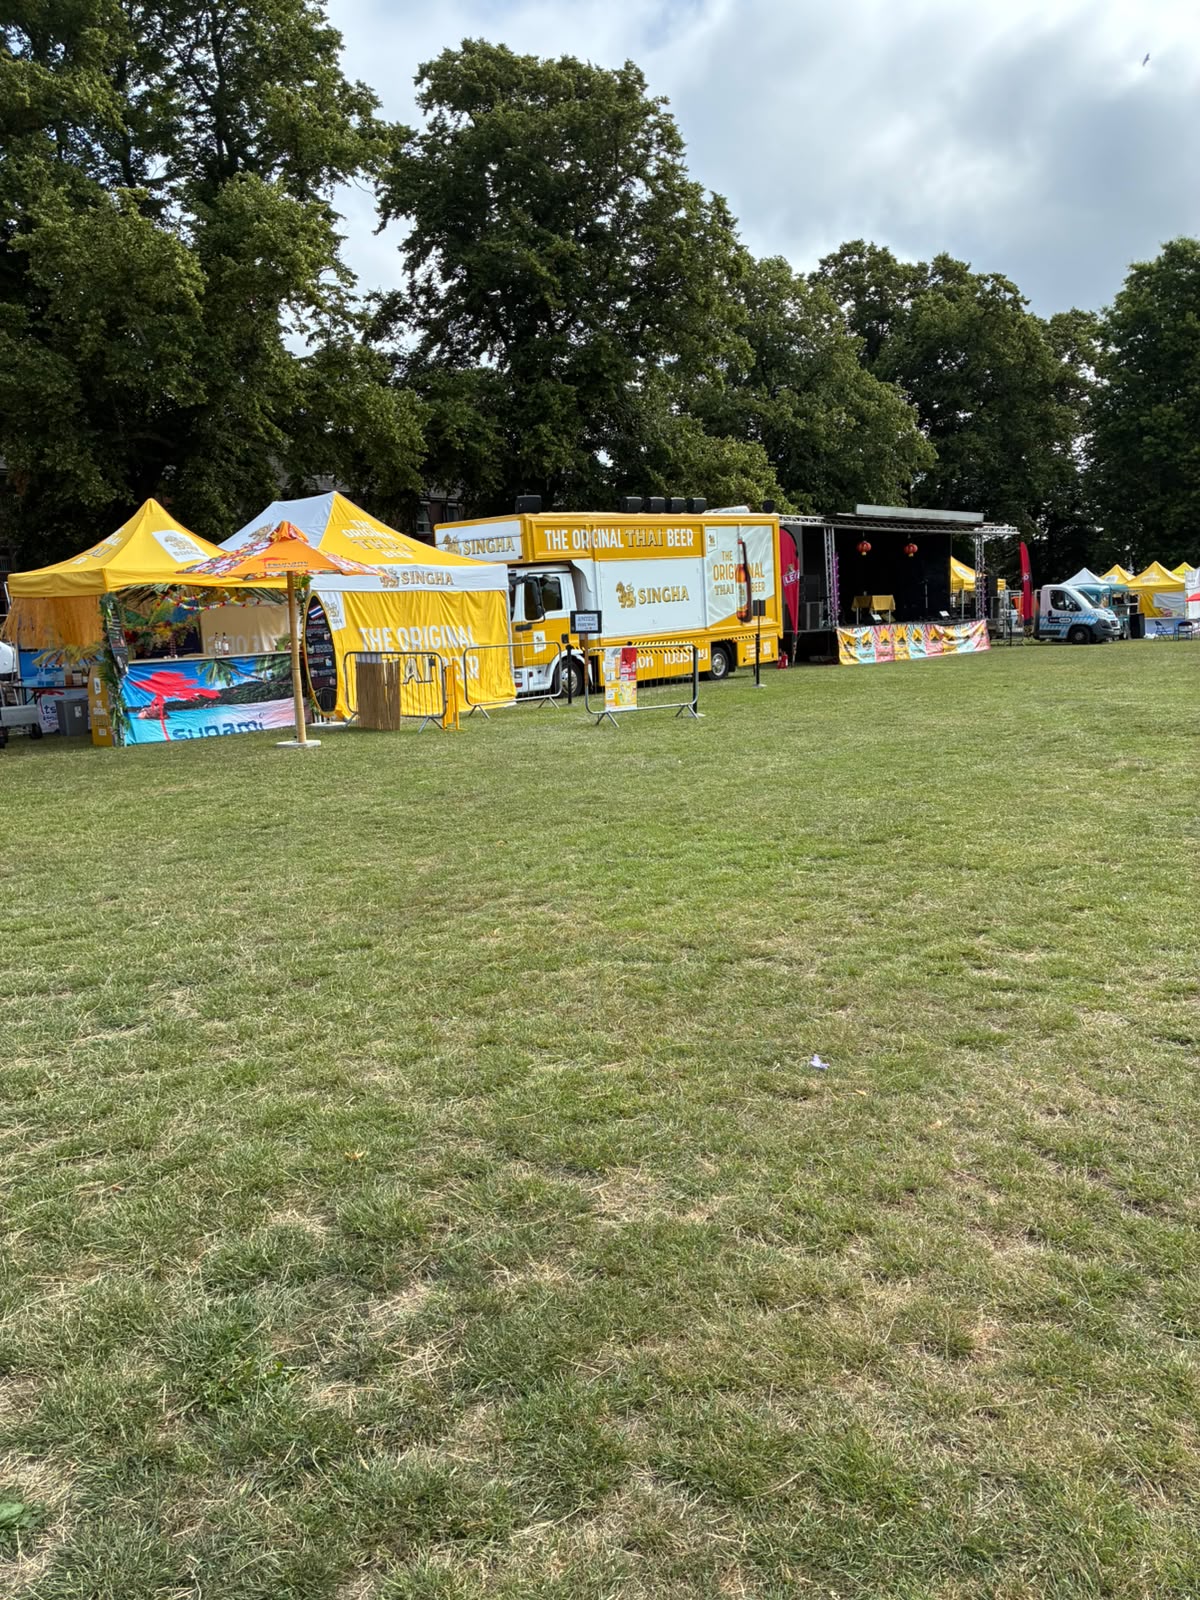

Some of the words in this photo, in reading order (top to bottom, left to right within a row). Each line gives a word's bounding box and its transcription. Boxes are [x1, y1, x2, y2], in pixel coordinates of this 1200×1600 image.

[463, 536, 515, 556] SINGHA
[544, 529, 569, 550] THE
[572, 528, 624, 549] ORIGINAL
[625, 528, 663, 547] THAI
[667, 528, 694, 547] BEER
[721, 551, 733, 561] THE
[400, 571, 454, 586] SINGHA
[714, 584, 735, 596] THAI
[751, 581, 766, 593] BEER
[638, 585, 690, 606] SINGHA
[359, 627, 394, 652] THE
[397, 625, 479, 652] ORIGINAL
